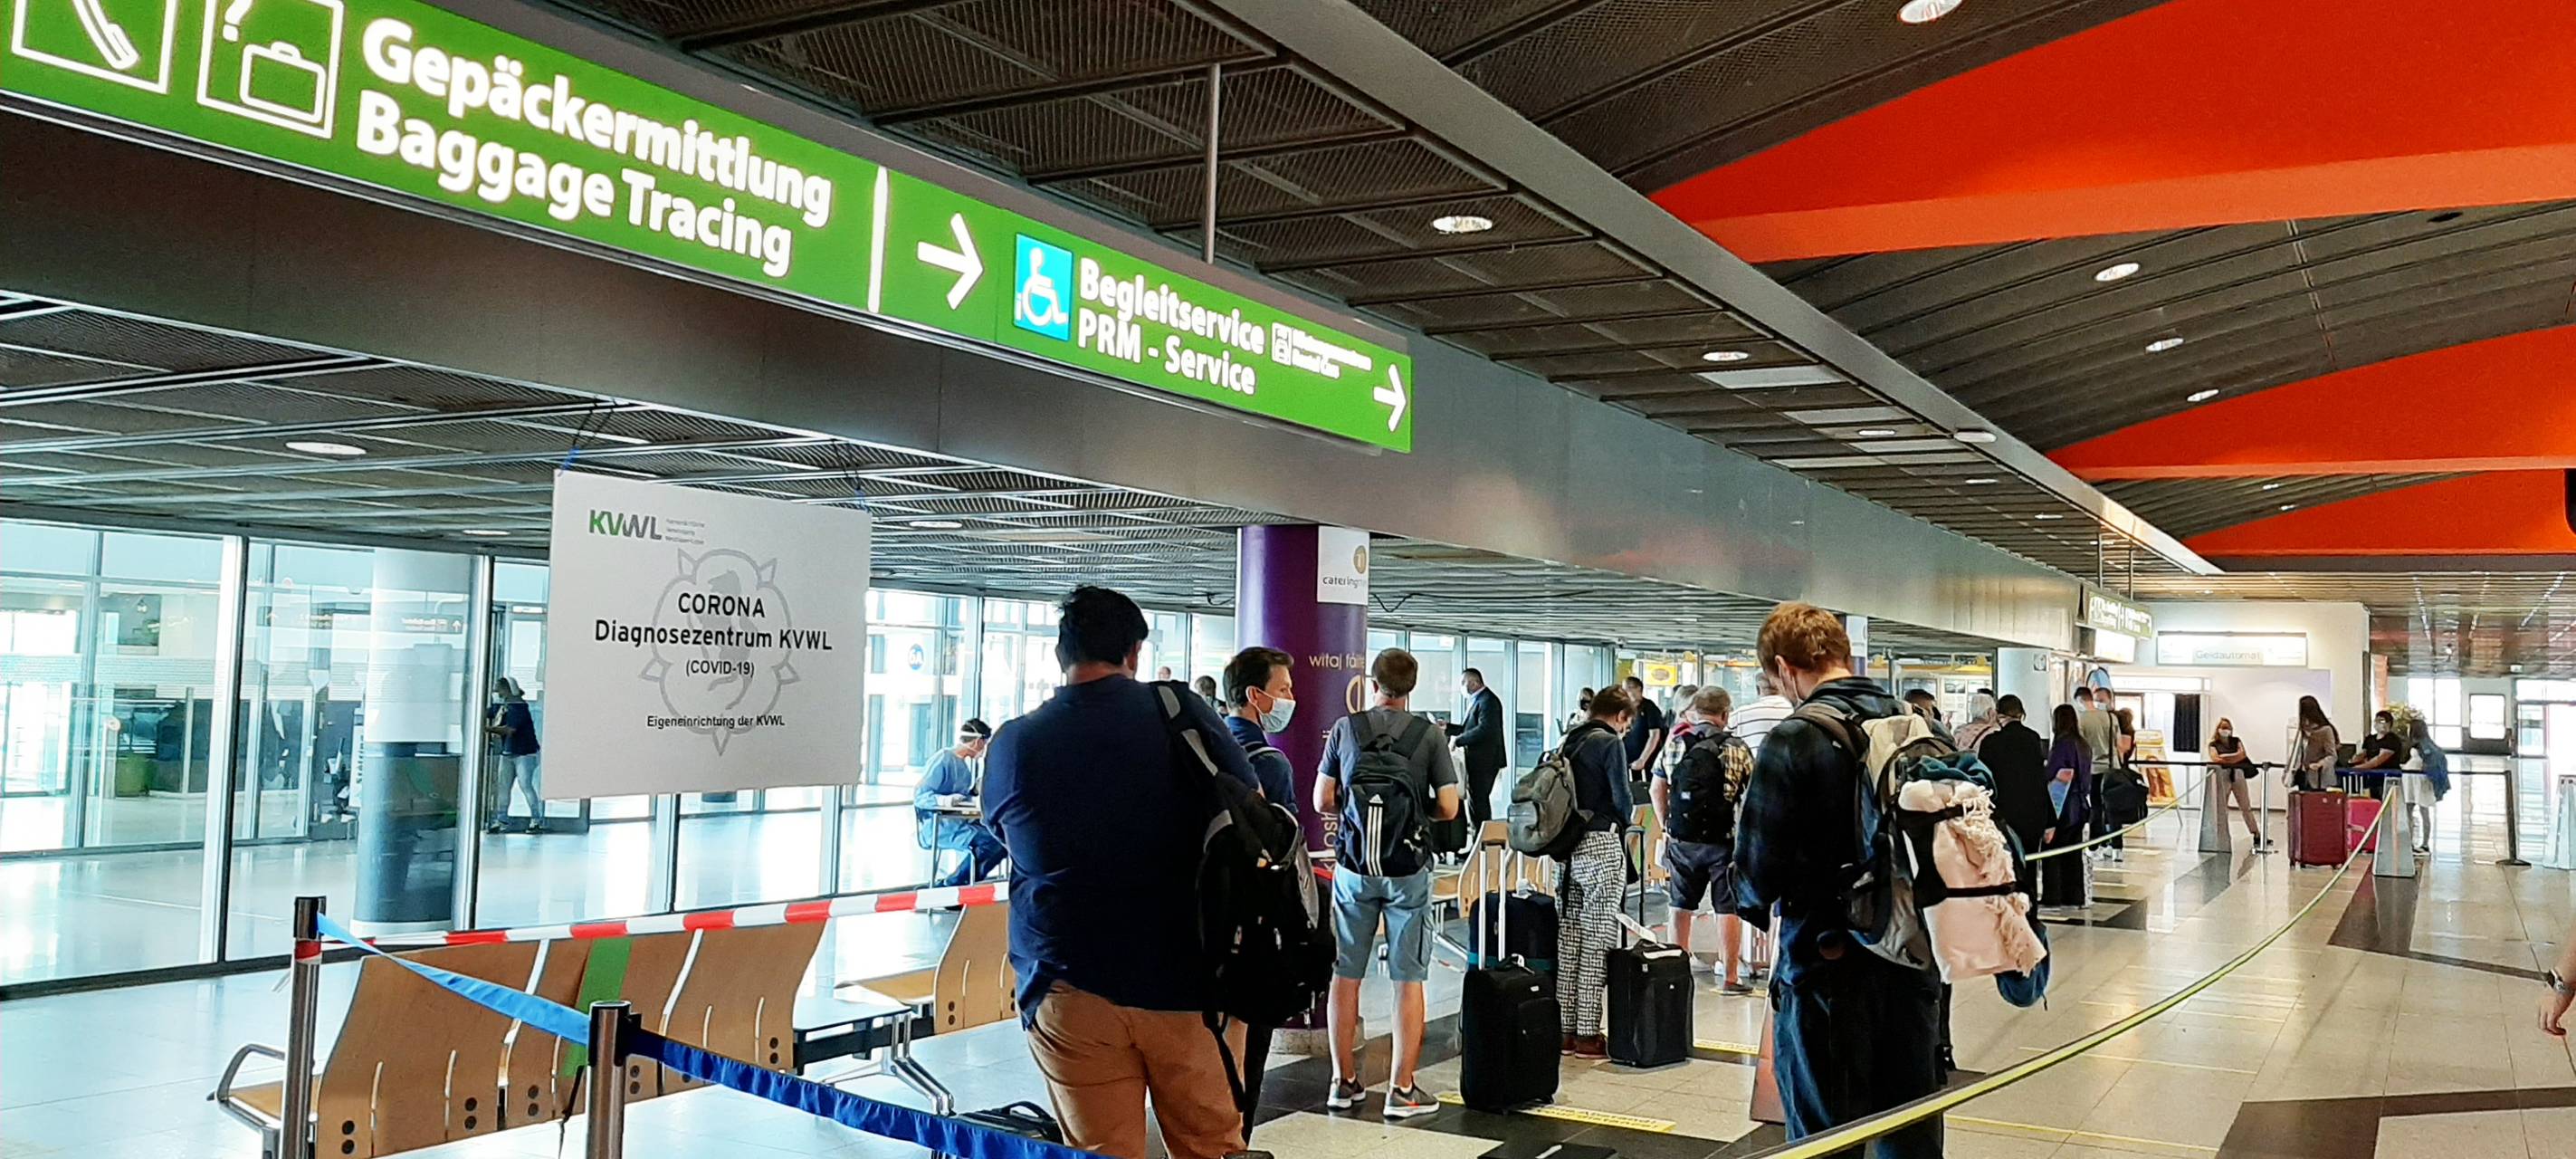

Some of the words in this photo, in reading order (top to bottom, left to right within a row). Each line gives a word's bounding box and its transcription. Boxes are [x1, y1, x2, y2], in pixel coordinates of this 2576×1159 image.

[363, 18, 833, 227] Gepäckermittlung
[357, 90, 614, 221] Baggage
[622, 168, 793, 278] Tracing
[1080, 257, 1264, 354] Begleitservice
[1078, 309, 1141, 363] PRM
[1166, 339, 1255, 395] Service
[589, 509, 662, 541] KVWL
[678, 592, 765, 618] CORONA
[596, 619, 772, 648] Diagnosezentrum
[779, 629, 833, 650] KVWL
[685, 660, 755, 677] (COVID-19)
[647, 714, 735, 729] Eigeneinrichtung
[738, 716, 754, 727] der
[756, 715, 785, 727] KVWL
